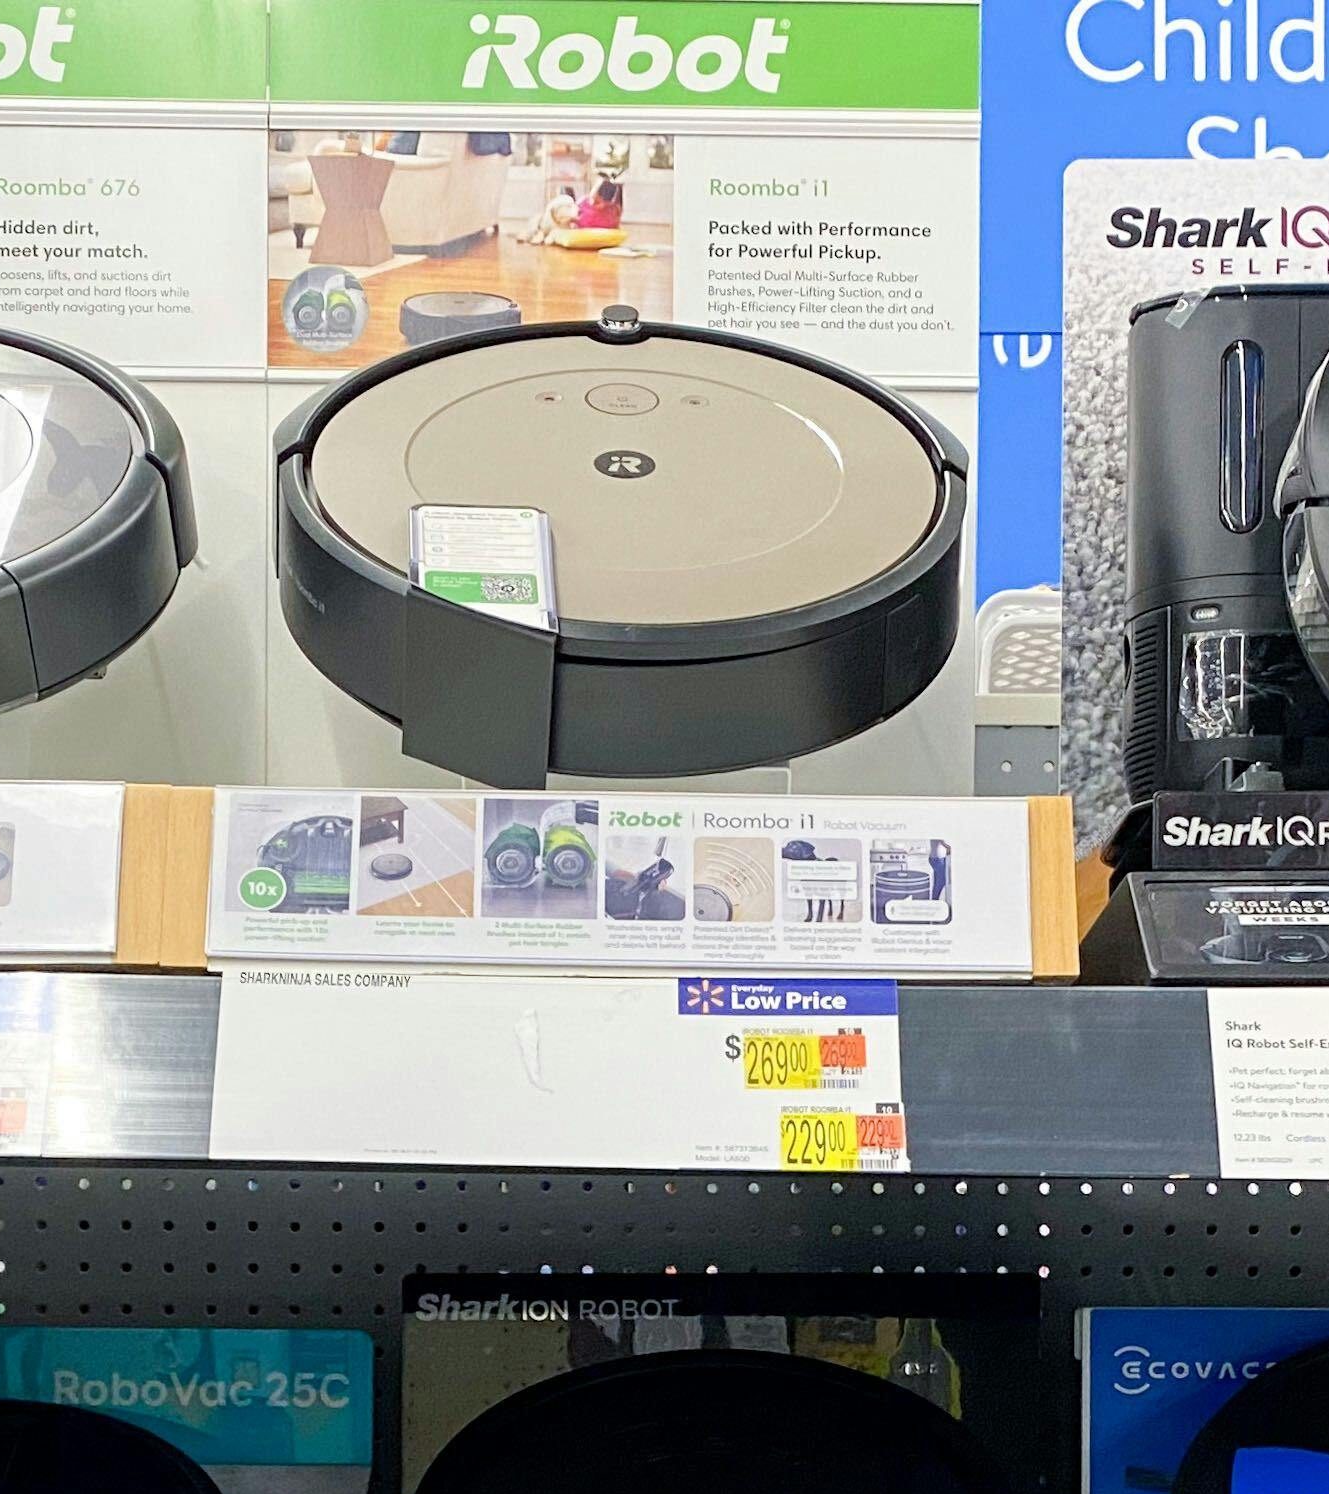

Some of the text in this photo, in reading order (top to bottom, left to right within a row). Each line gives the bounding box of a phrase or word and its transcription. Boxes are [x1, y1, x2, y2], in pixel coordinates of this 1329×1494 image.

[461, 14, 790, 93] iRobot
[101, 180, 139, 196] 676
[815, 180, 827, 196] i1
[63, 220, 98, 236] dirt,
[710, 220, 930, 237] Packed with Performance
[1107, 207, 1271, 248] Shark
[44, 247, 81, 262] your
[88, 243, 147, 258] match.
[709, 243, 880, 264] for Powerful Pickup.
[48, 270, 70, 281] lifts,
[74, 270, 97, 281] and
[101, 271, 148, 281] suctions
[152, 271, 171, 281] dirt
[709, 270, 917, 283] Patented Dual Multi-Surface Rubber
[609, 811, 814, 830] iRobot Roomba i1
[1163, 816, 1272, 847] Shark
[249, 882, 276, 895] 10x
[240, 972, 410, 988] SHARKNINJA SALES COMPANY
[731, 985, 774, 994] Everyday
[731, 991, 847, 1010] Low Price
[1225, 1021, 1261, 1030] Shark
[1227, 1039, 1242, 1048] IQ
[1247, 1039, 1285, 1048] Robot
[416, 1294, 520, 1322] Shark
[580, 1299, 679, 1321] ROBOT
[54, 1371, 350, 1408] RoboVac 25C
